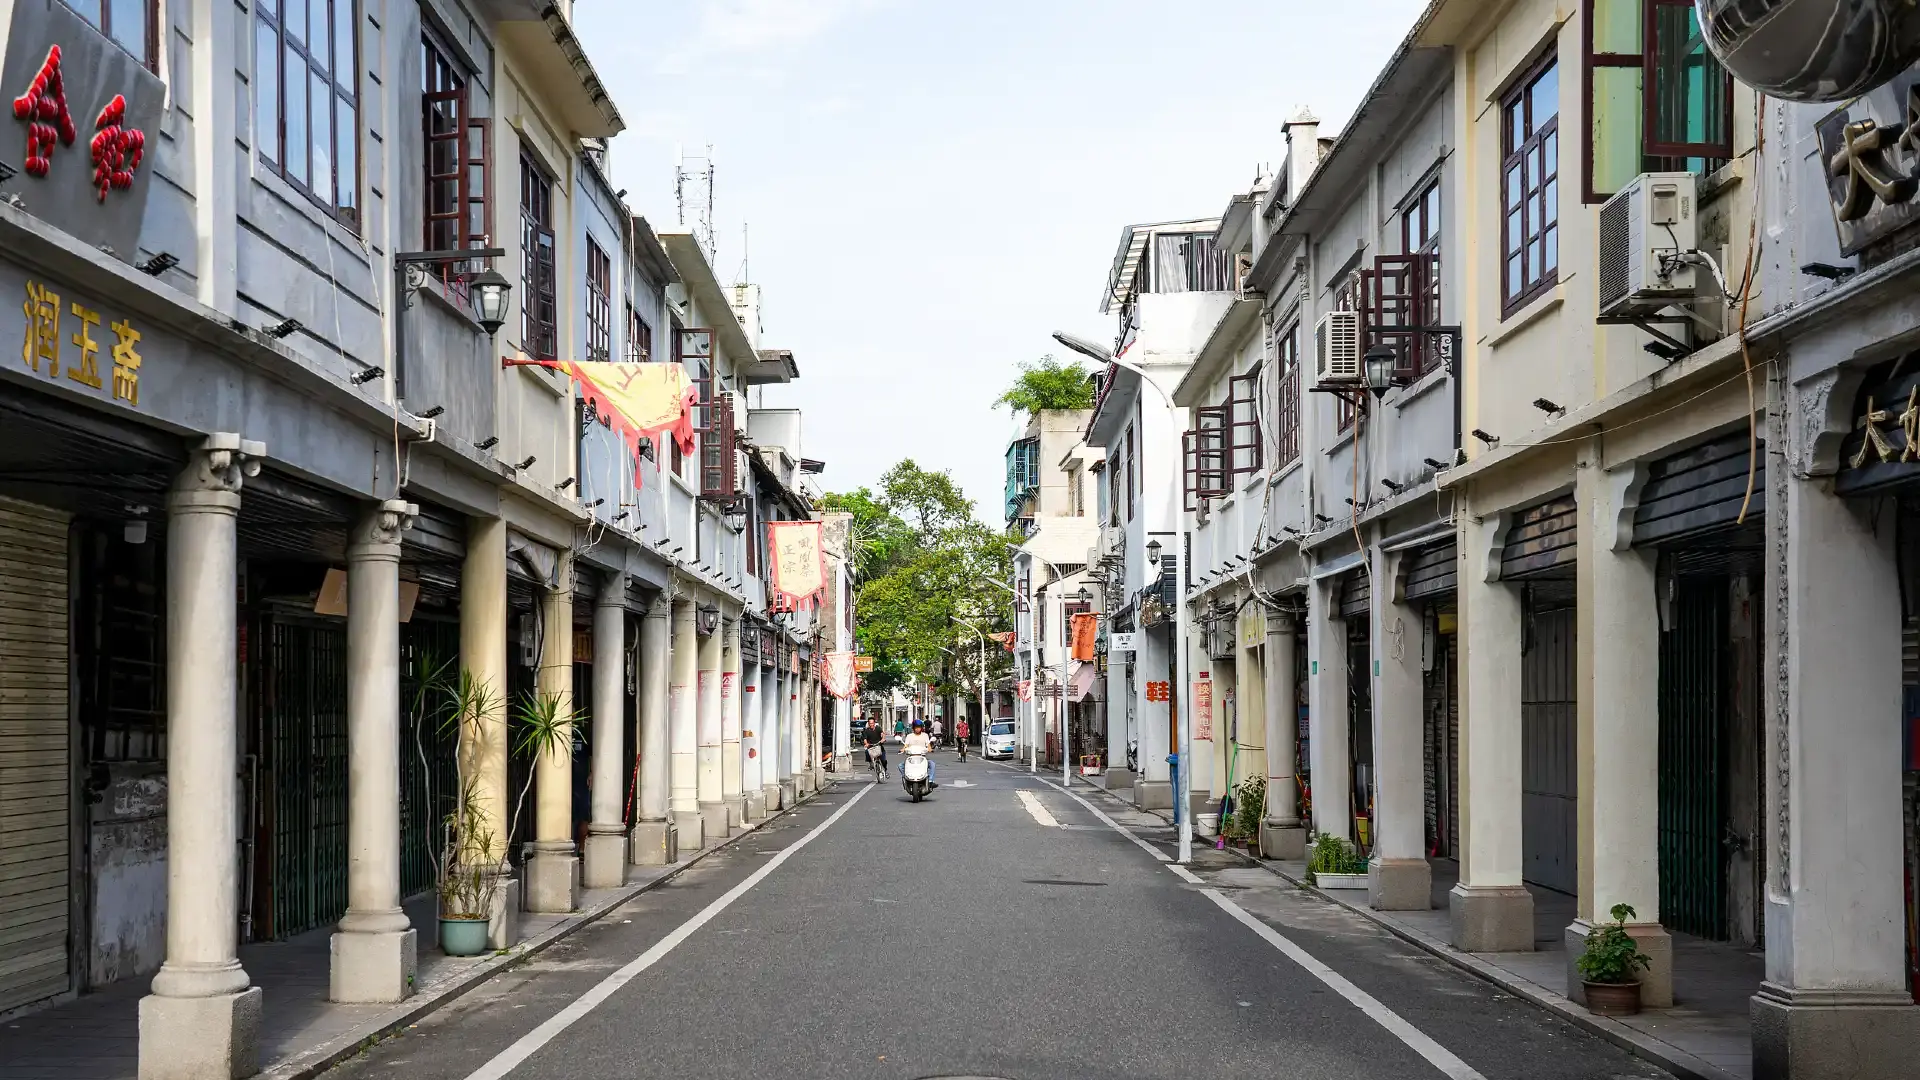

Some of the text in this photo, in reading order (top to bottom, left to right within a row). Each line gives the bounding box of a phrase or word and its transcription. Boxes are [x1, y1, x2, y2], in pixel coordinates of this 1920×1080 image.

[1831, 84, 1920, 222] 大
[23, 280, 141, 407] 润玉斋
[1146, 681, 1169, 702] 鞋
